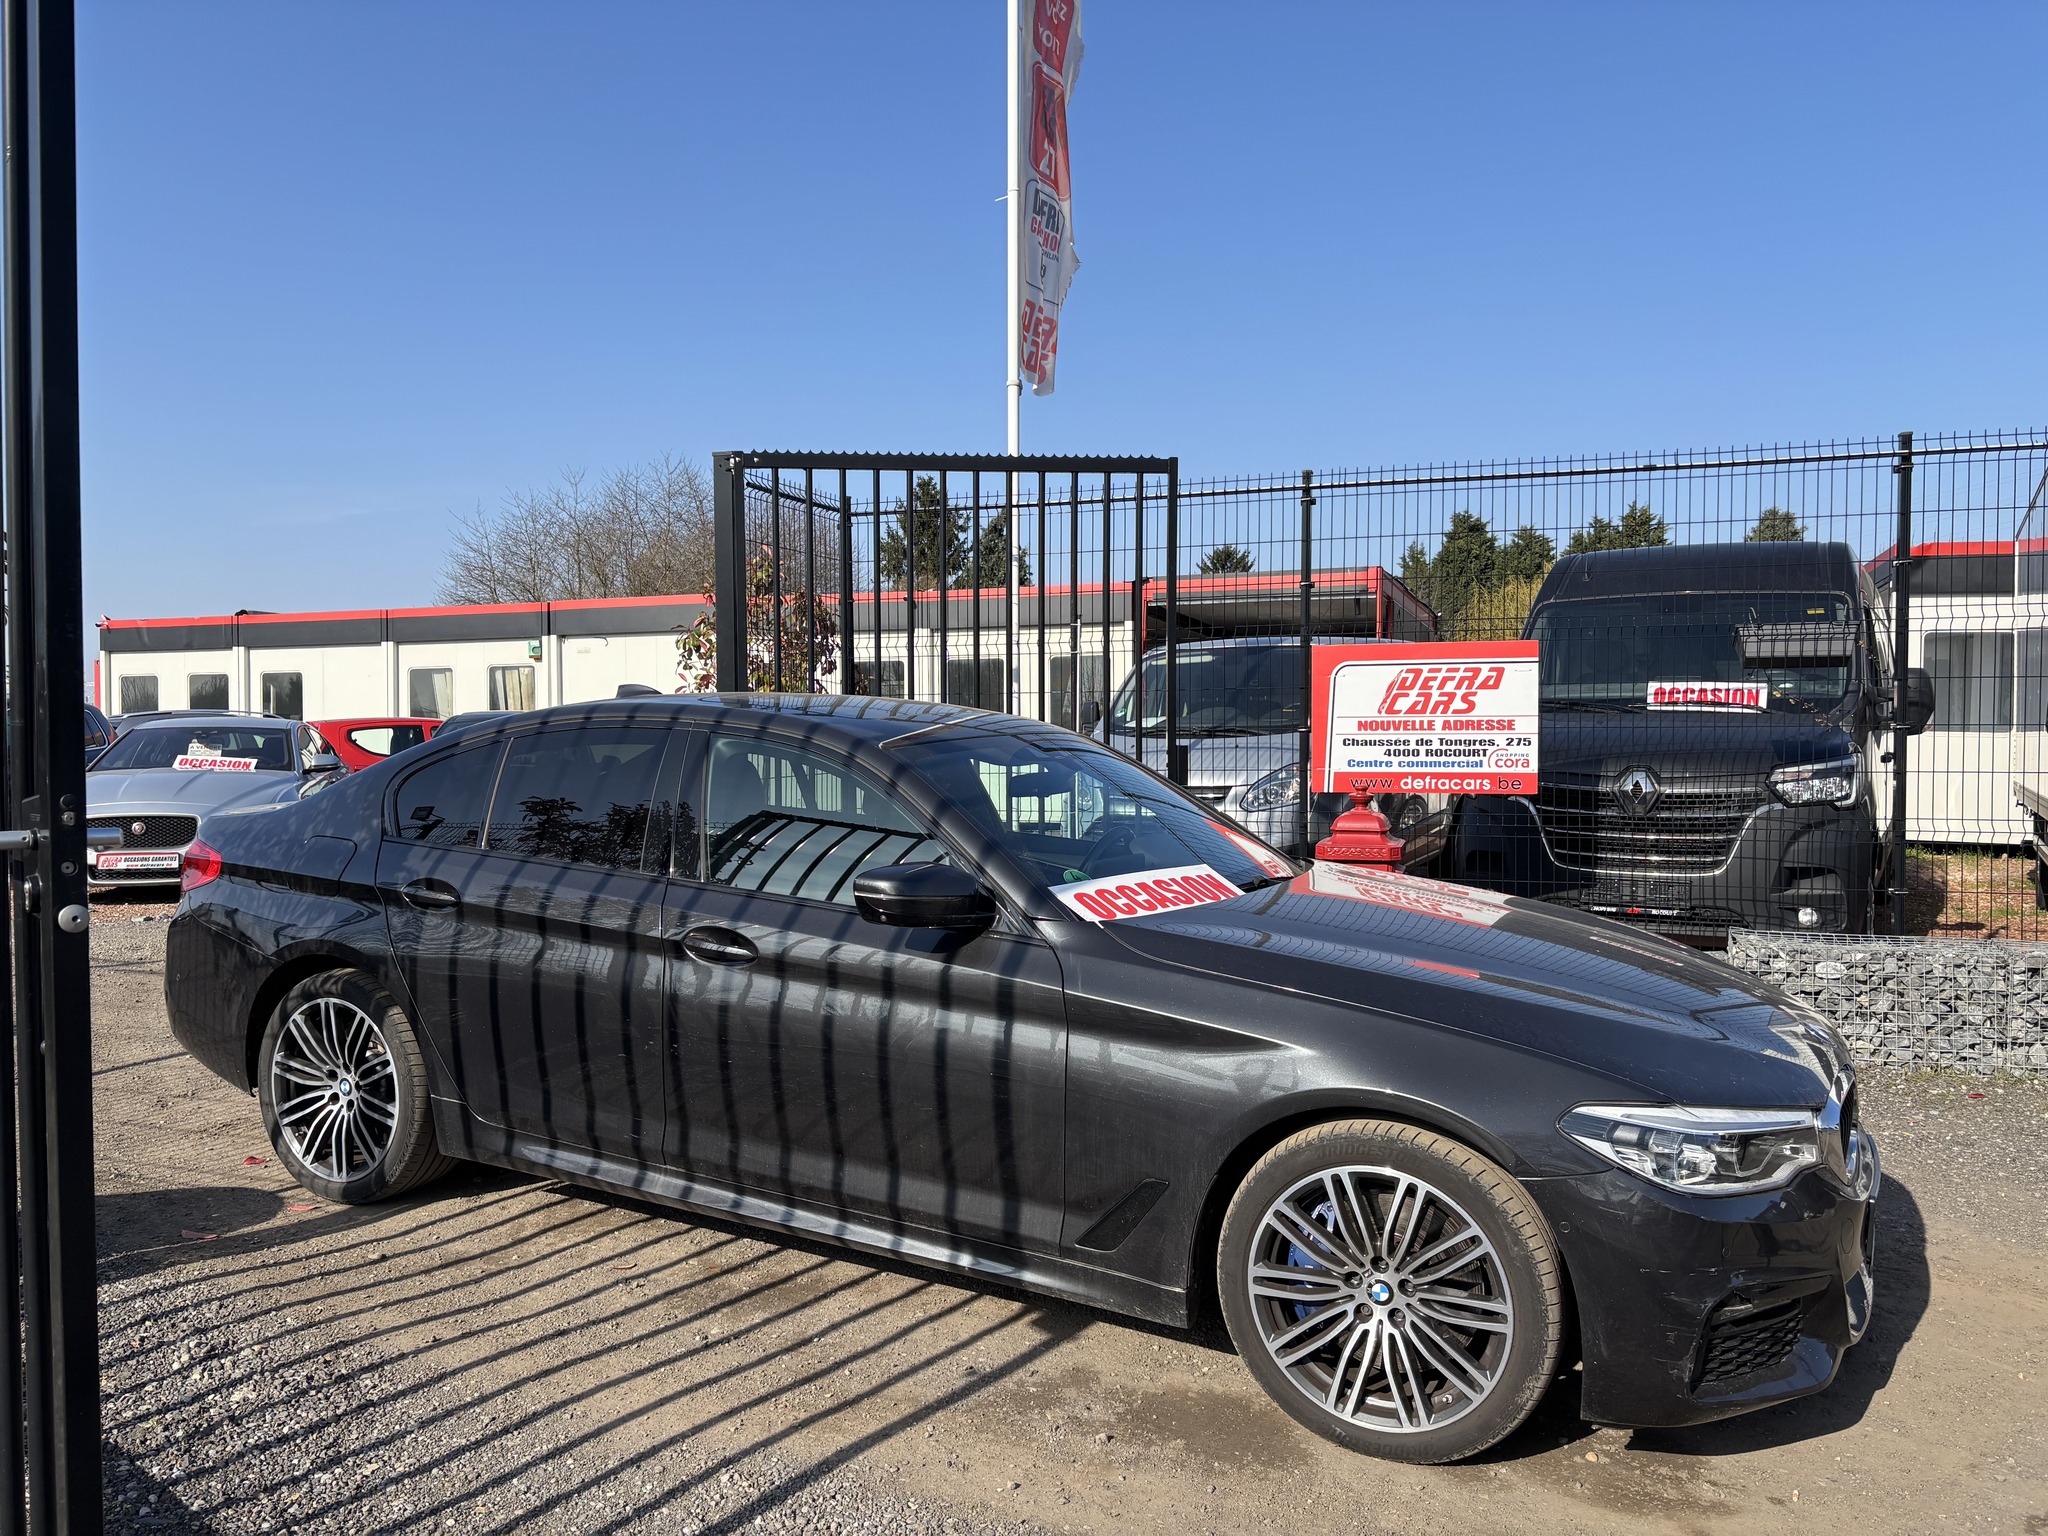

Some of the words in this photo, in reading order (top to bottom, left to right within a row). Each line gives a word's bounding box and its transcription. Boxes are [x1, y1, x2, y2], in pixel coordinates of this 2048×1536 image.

[1395, 667, 1505, 691] DEFRA
[1653, 686, 1760, 706] OCCASION
[1384, 691, 1478, 715] CARS
[1357, 719, 1436, 732] NOUVELLE
[1441, 719, 1516, 731] ADRESSE
[1342, 737, 1411, 747] Chaussée
[1415, 737, 1433, 747] de
[1438, 737, 1500, 748] Tongres,
[1505, 737, 1532, 747] 275
[1383, 748, 1421, 757] 4000
[1425, 748, 1489, 757] ROCOURT
[178, 757, 253, 770] OCCASION
[1347, 759, 1393, 768] Centre
[1397, 759, 1484, 768] commercial
[1494, 757, 1530, 769] cora
[1073, 873, 1240, 920] OCCASION
